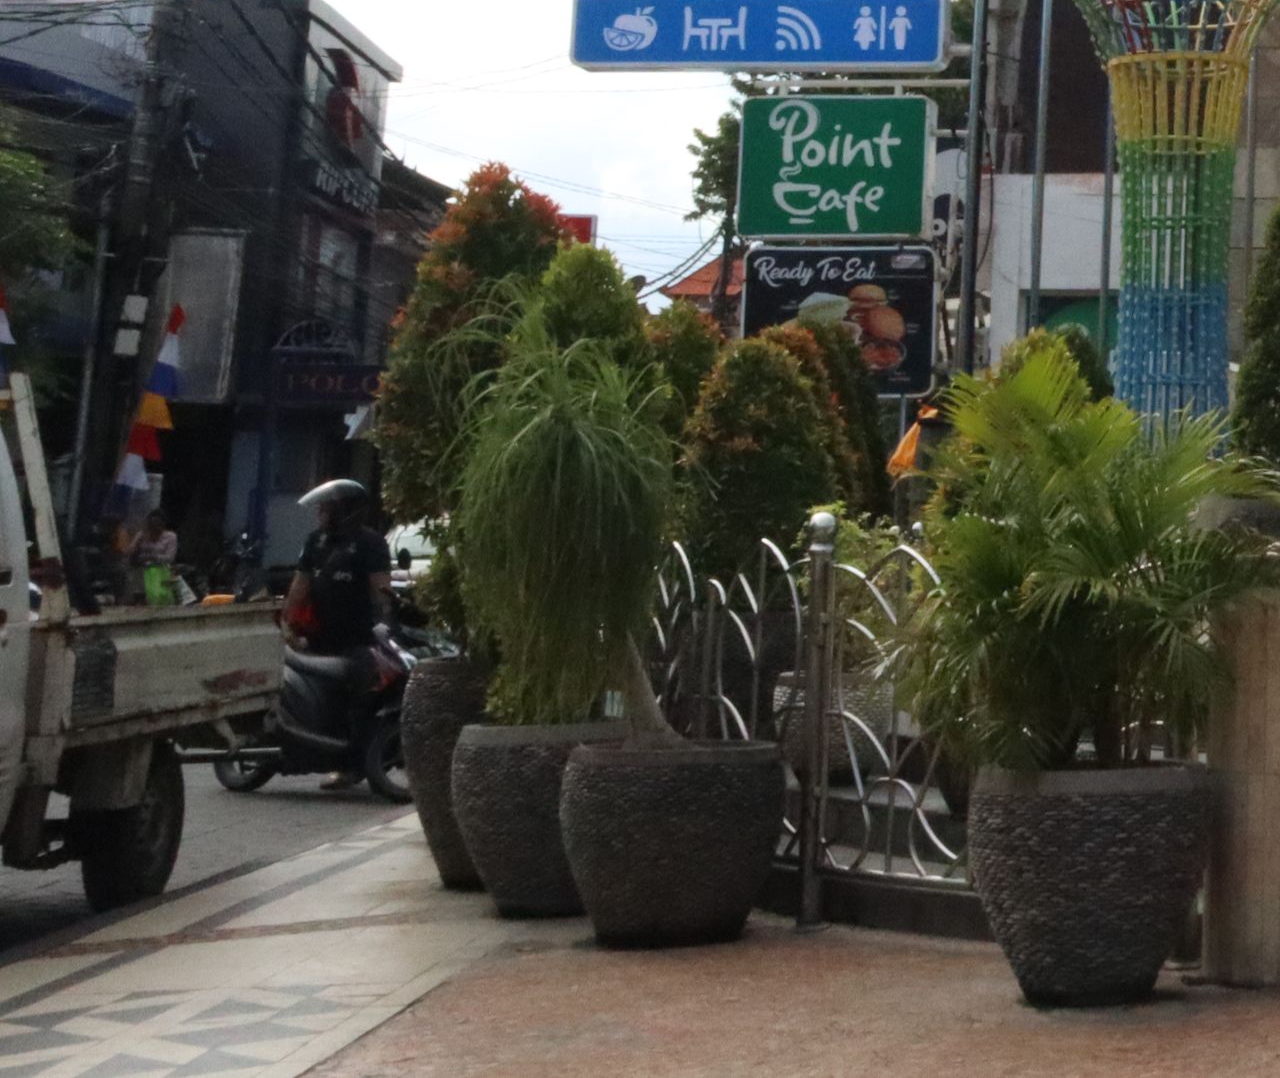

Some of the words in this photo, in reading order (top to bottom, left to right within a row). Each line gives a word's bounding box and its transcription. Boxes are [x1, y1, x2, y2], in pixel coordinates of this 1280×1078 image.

[768, 99, 902, 169] Point
[772, 180, 885, 233] Cafe
[753, 256, 815, 287] Ready
[816, 256, 843, 282] To
[842, 257, 877, 283] Eat
[287, 373, 382, 395] POLO
